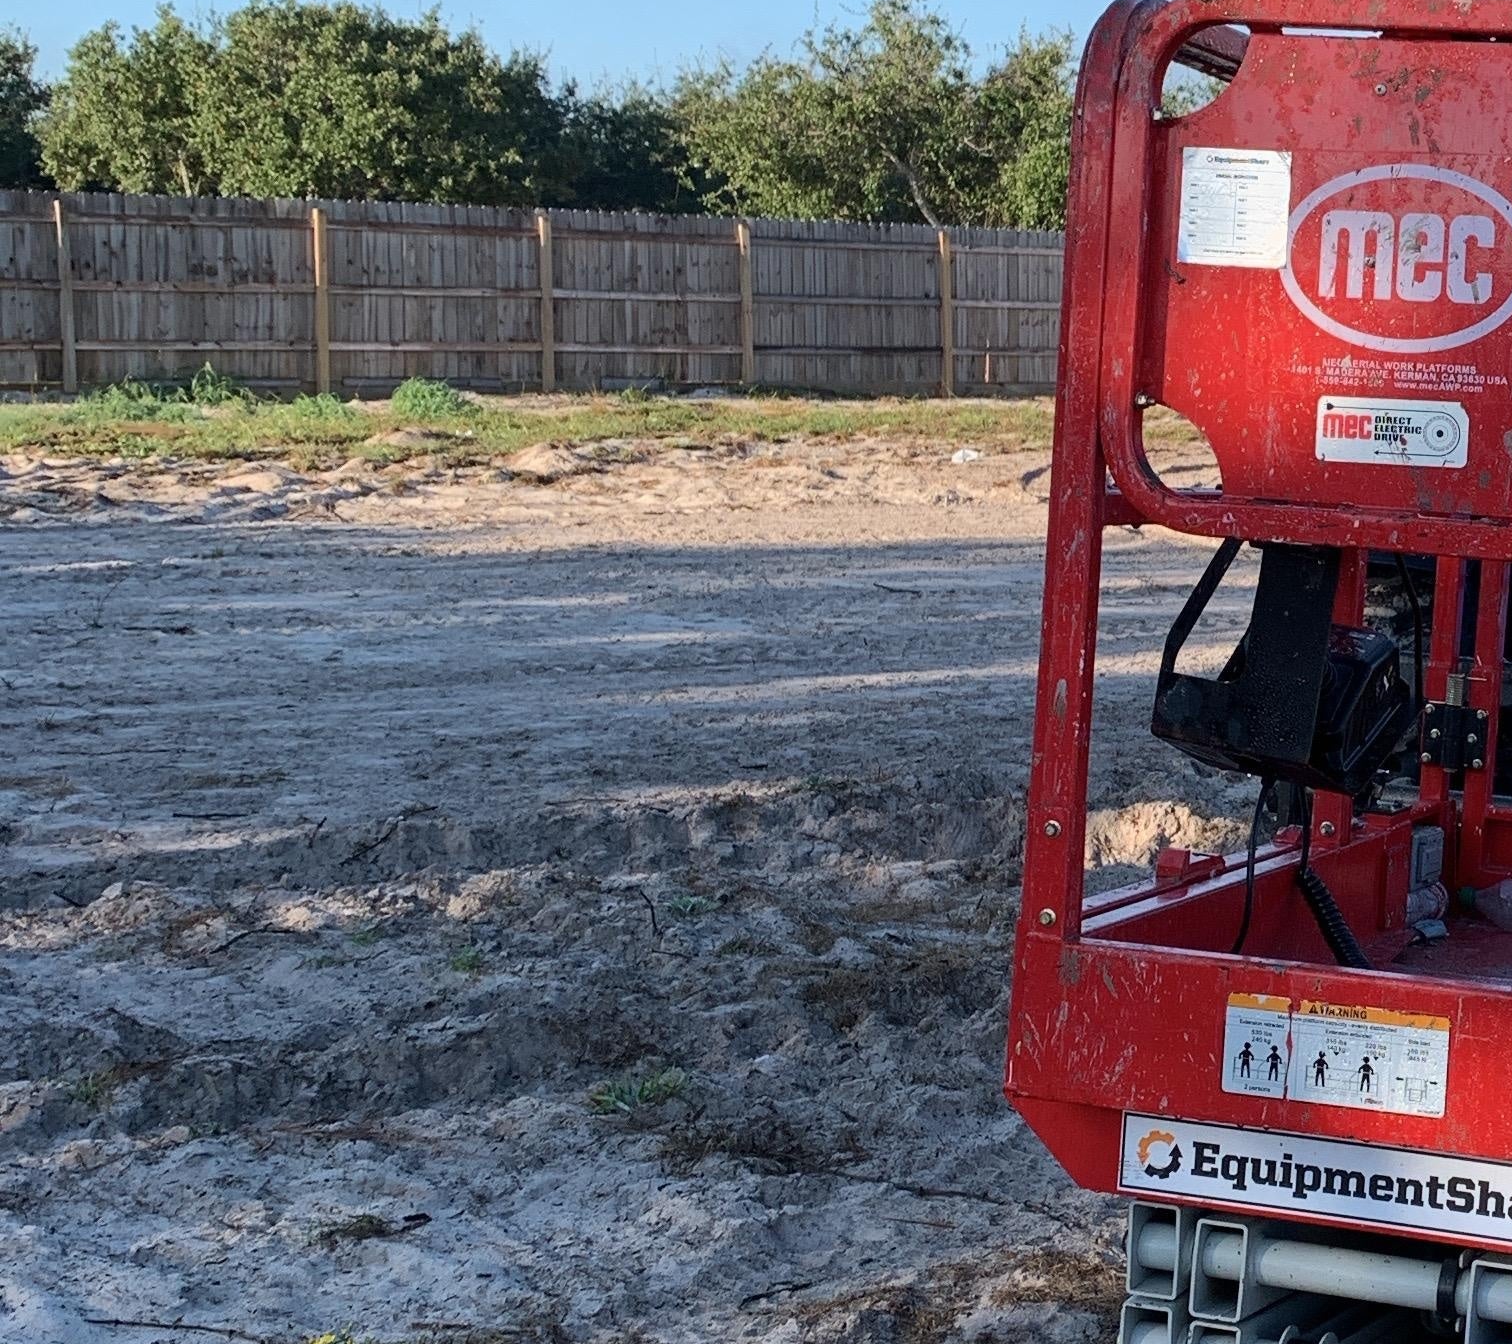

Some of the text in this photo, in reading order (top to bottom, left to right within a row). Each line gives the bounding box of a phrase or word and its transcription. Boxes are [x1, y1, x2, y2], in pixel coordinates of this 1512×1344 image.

[1384, 361, 1414, 372] WORK
[1416, 362, 1476, 375] PLATFORMS
[1326, 367, 1367, 377] MADERA
[1442, 372, 1456, 383] CA
[1487, 375, 1508, 385] USA
[1374, 415, 1412, 426] DIRECT
[1374, 424, 1423, 435] ELECTRIC
